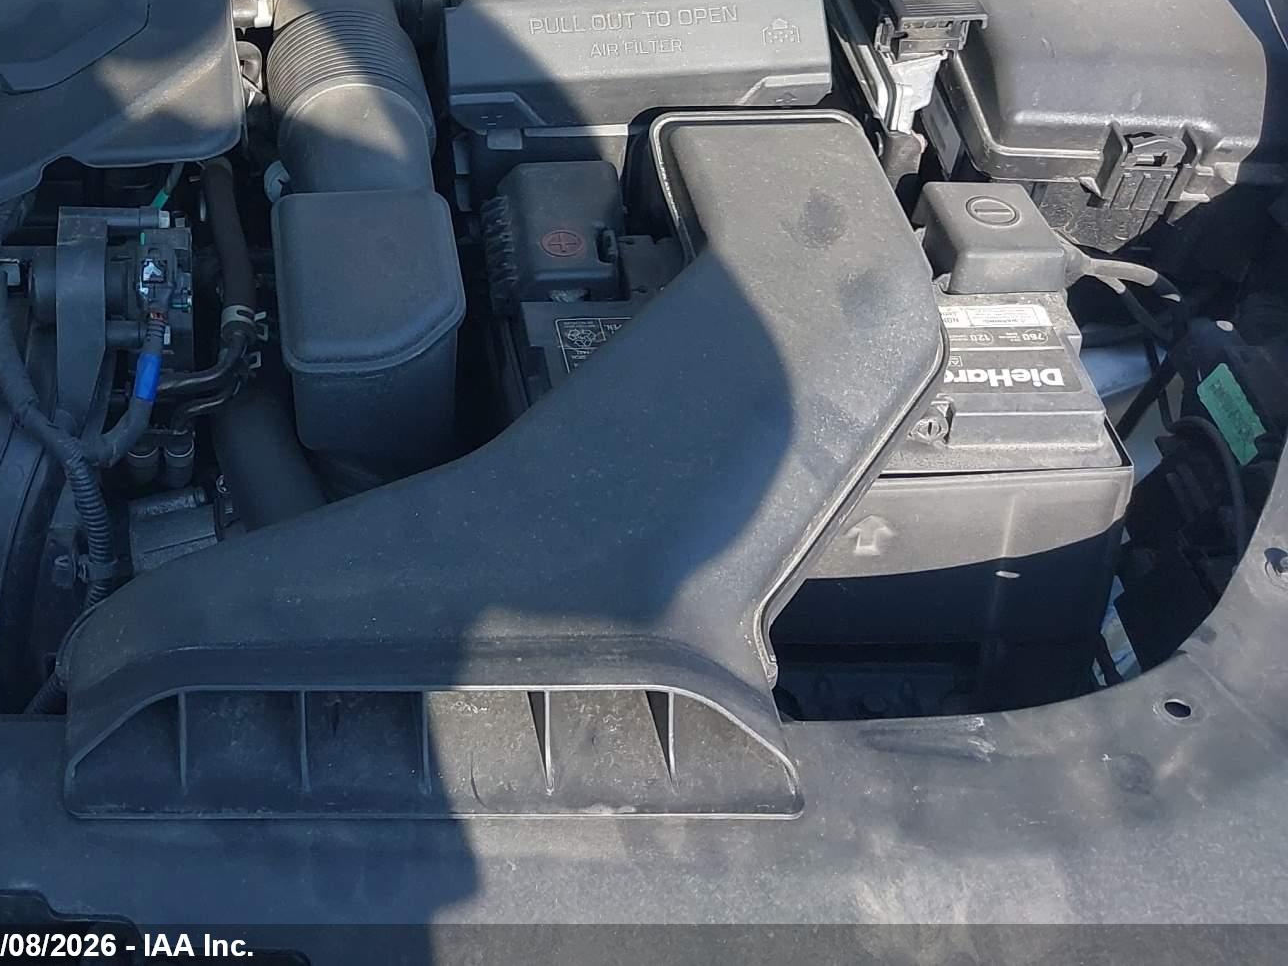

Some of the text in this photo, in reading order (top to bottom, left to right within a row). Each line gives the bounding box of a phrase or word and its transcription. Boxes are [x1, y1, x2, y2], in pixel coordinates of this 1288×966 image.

[528, 4, 739, 36] PULL OUT TO OPEN
[590, 37, 684, 59] AIR FILTER
